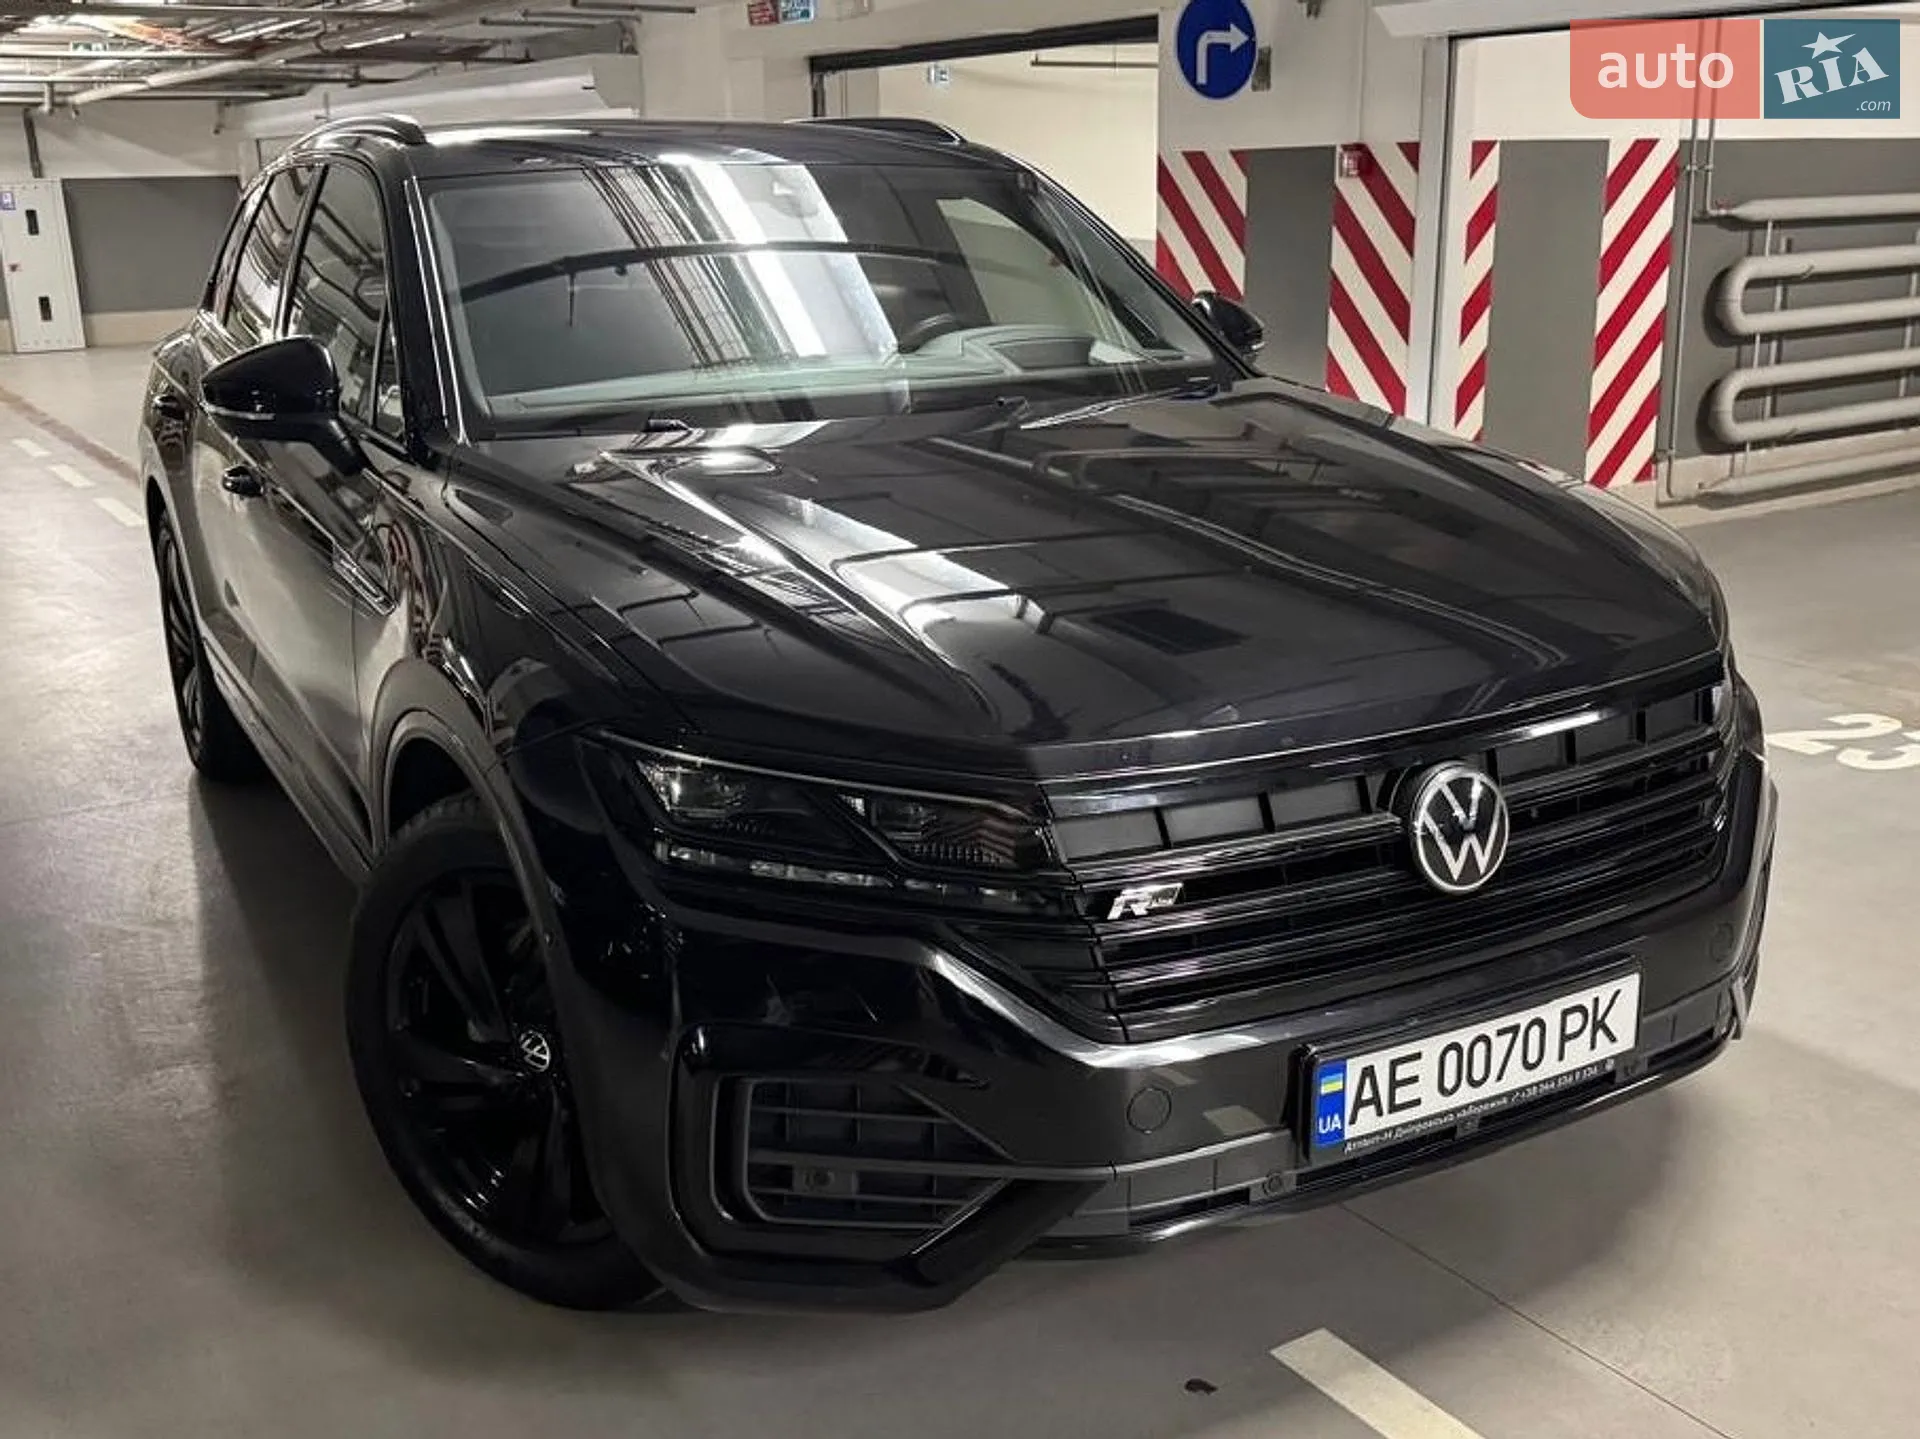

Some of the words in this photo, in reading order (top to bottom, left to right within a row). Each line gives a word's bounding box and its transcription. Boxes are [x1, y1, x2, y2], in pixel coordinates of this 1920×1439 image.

[1348, 1051, 1423, 1126] AE
[1437, 1016, 1547, 1098] 0070
[1557, 988, 1622, 1062] PK
[1318, 1114, 1342, 1135] UA
